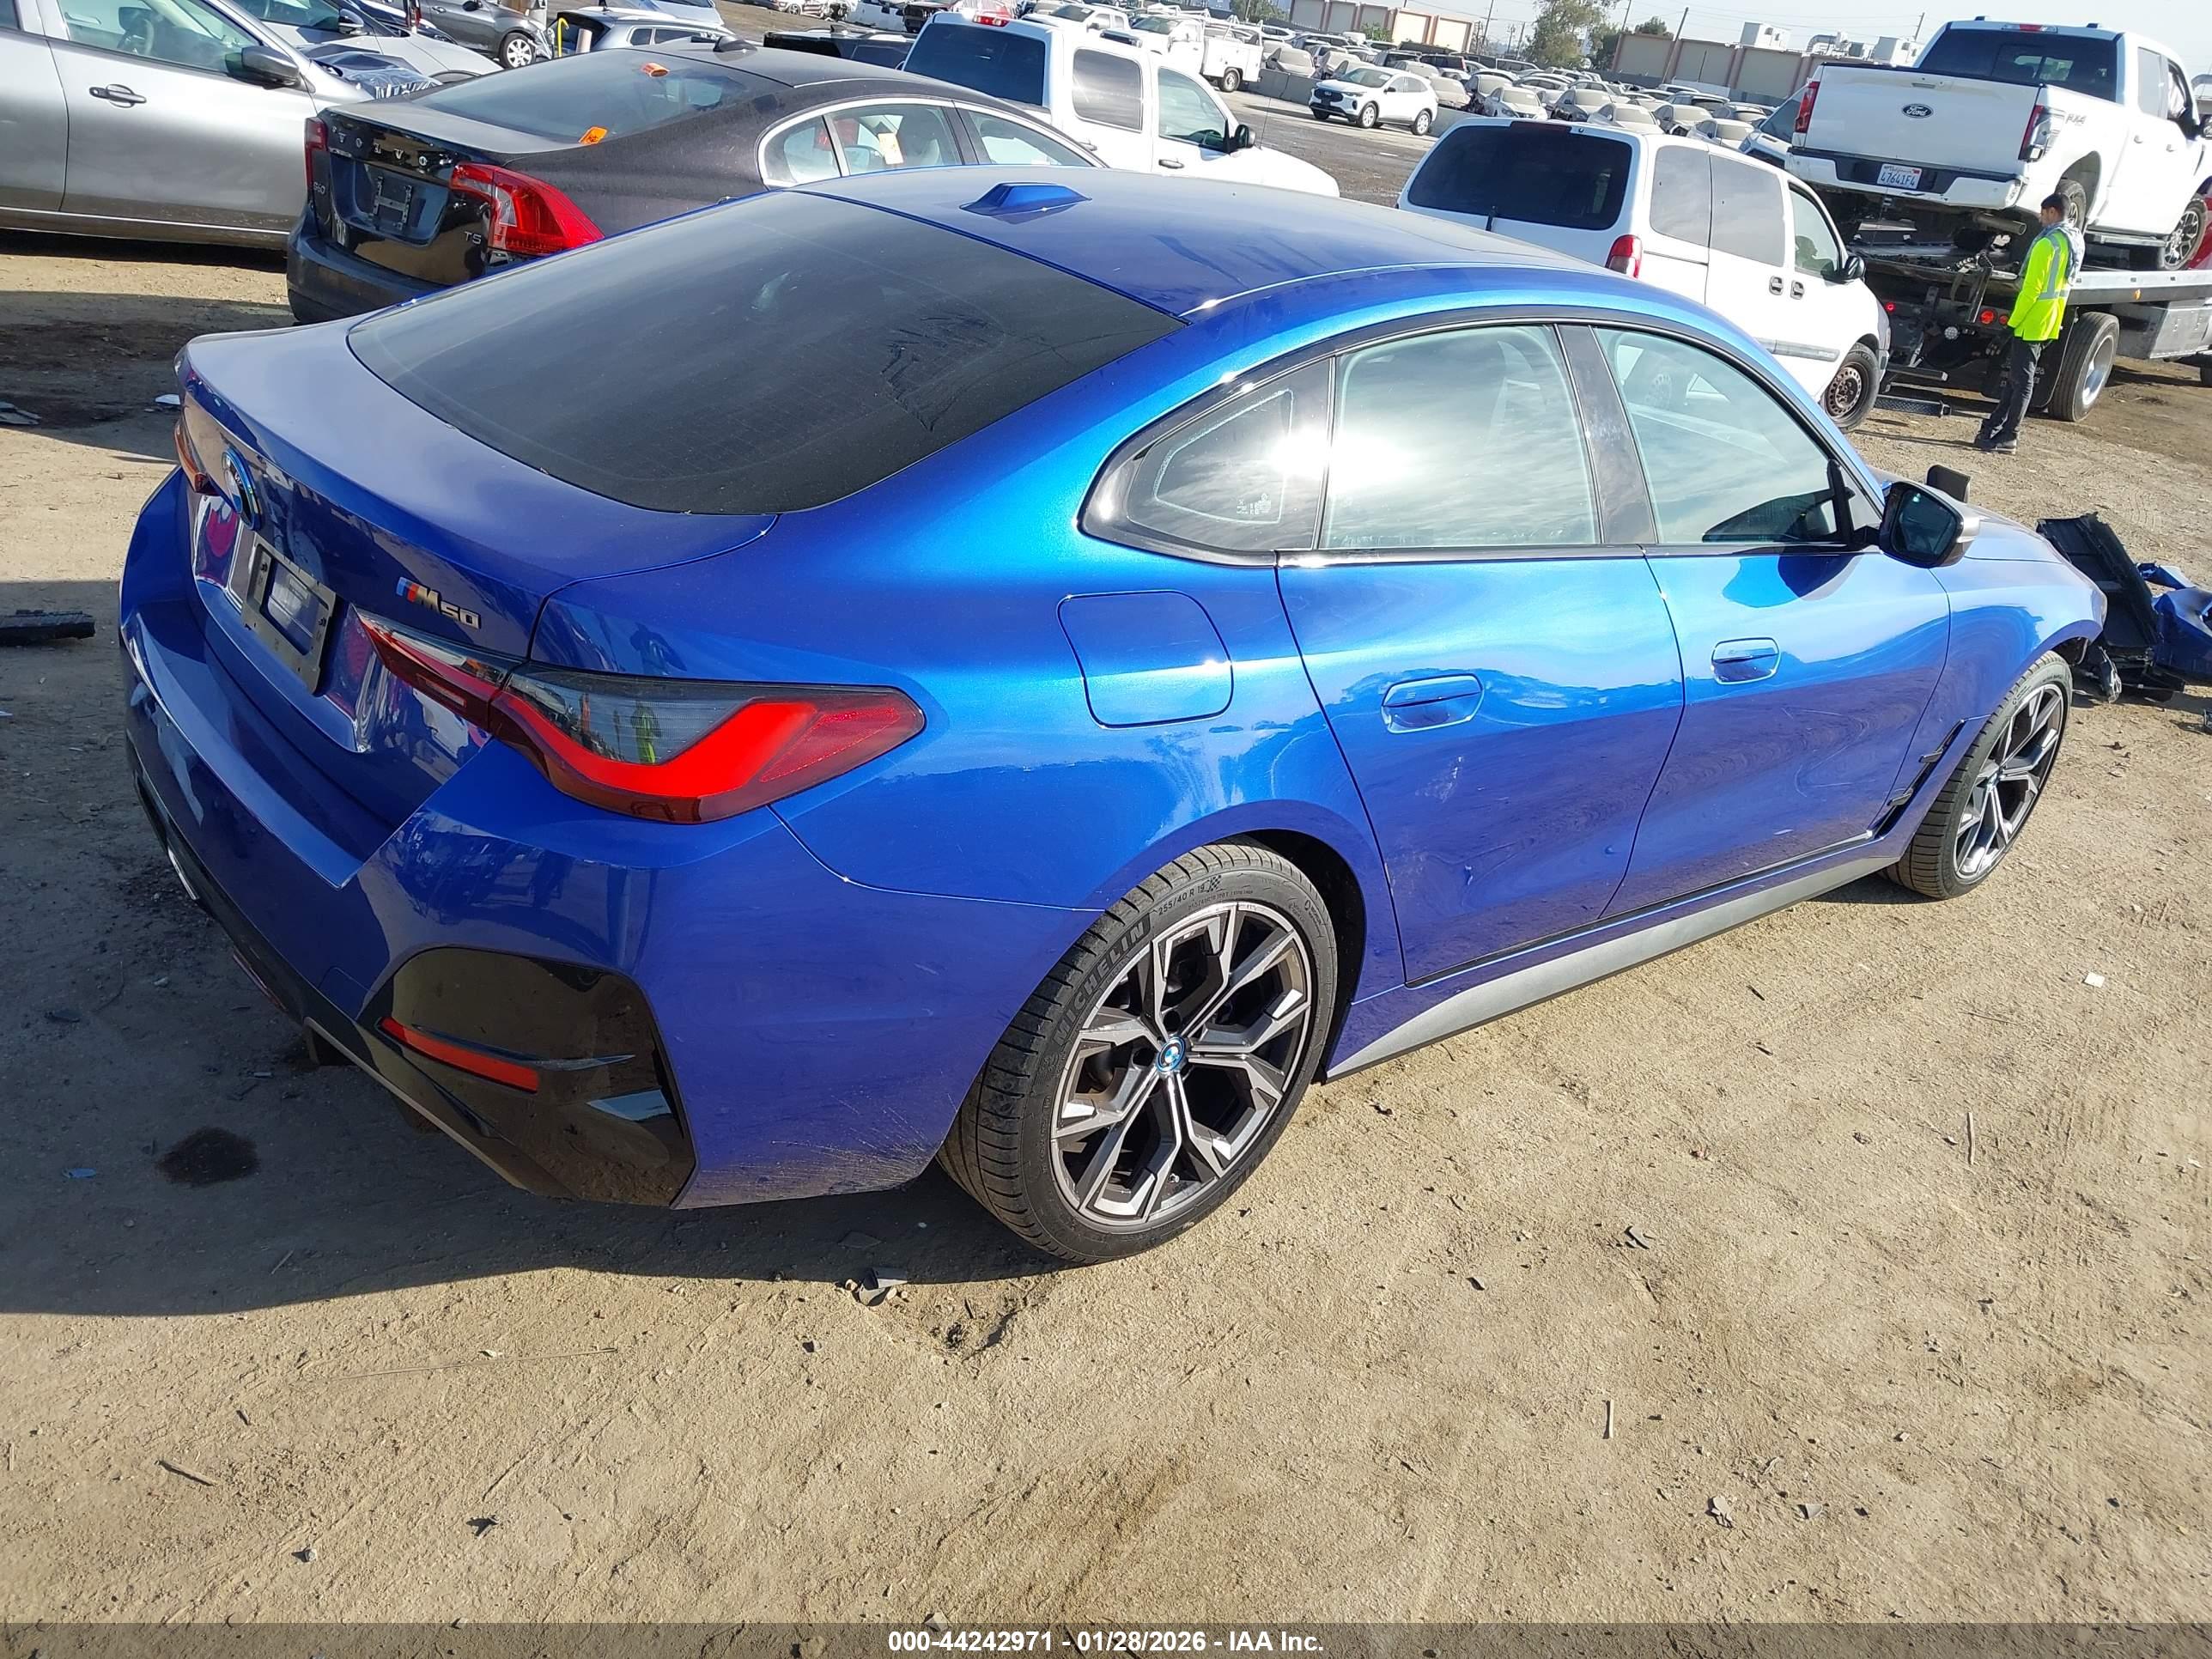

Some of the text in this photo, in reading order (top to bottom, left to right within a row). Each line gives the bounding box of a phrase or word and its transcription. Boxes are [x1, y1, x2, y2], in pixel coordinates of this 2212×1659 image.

[1906, 106, 1929, 116] Ford
[337, 132, 428, 167] VOLVO
[1881, 172, 1916, 185] 47641F4
[416, 585, 480, 630] M50
[1158, 893, 1188, 916] 255/40
[1198, 883, 1205, 894] 19
[1053, 921, 1146, 1044] MICHELIN
